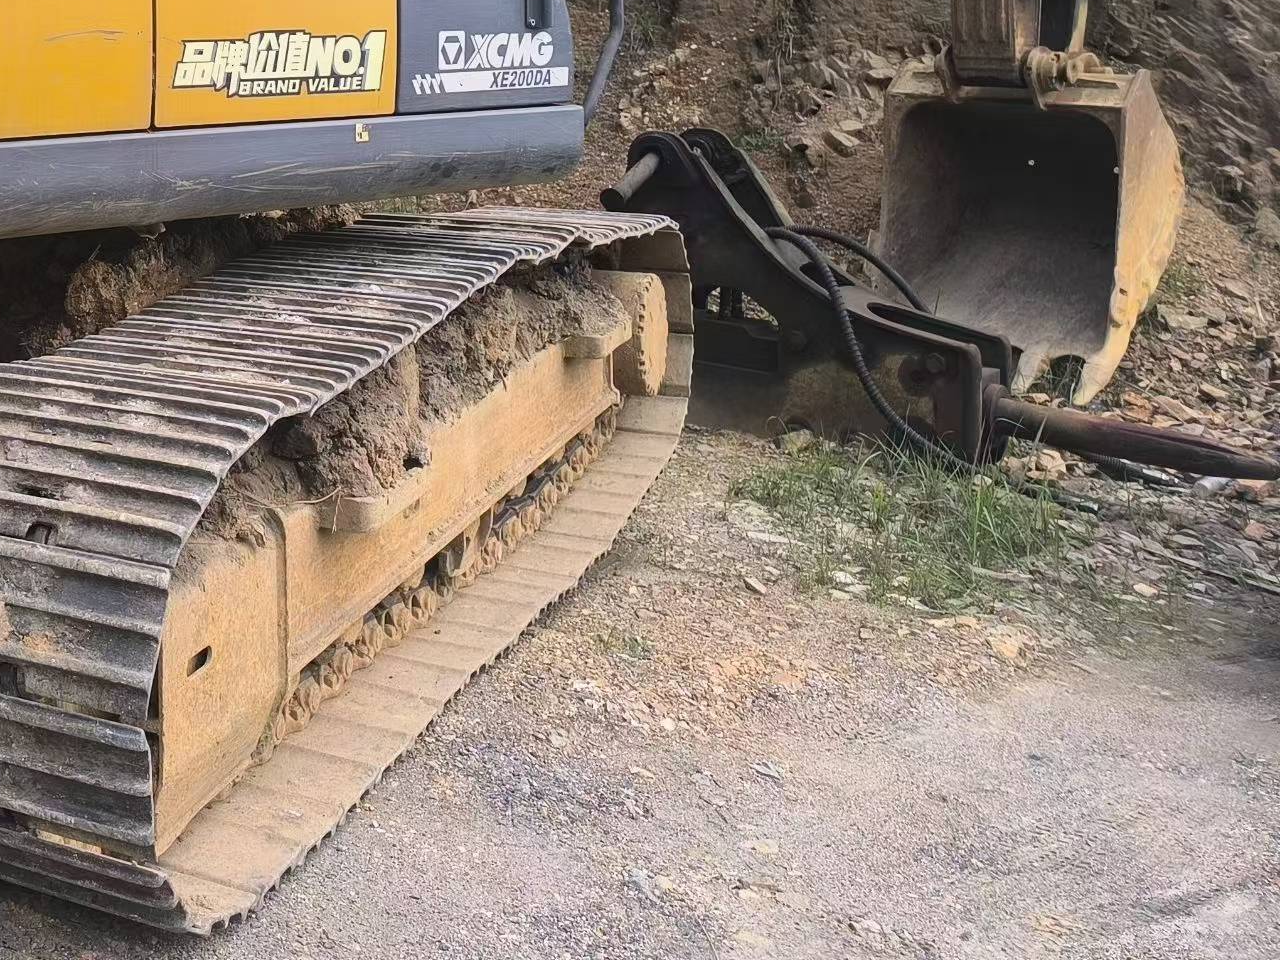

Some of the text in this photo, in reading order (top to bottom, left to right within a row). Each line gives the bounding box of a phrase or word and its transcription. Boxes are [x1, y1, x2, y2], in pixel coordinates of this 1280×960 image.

[464, 31, 554, 69] XCMG
[239, 77, 362, 95] BRAND VALUE
[490, 70, 551, 88] XE200DA
